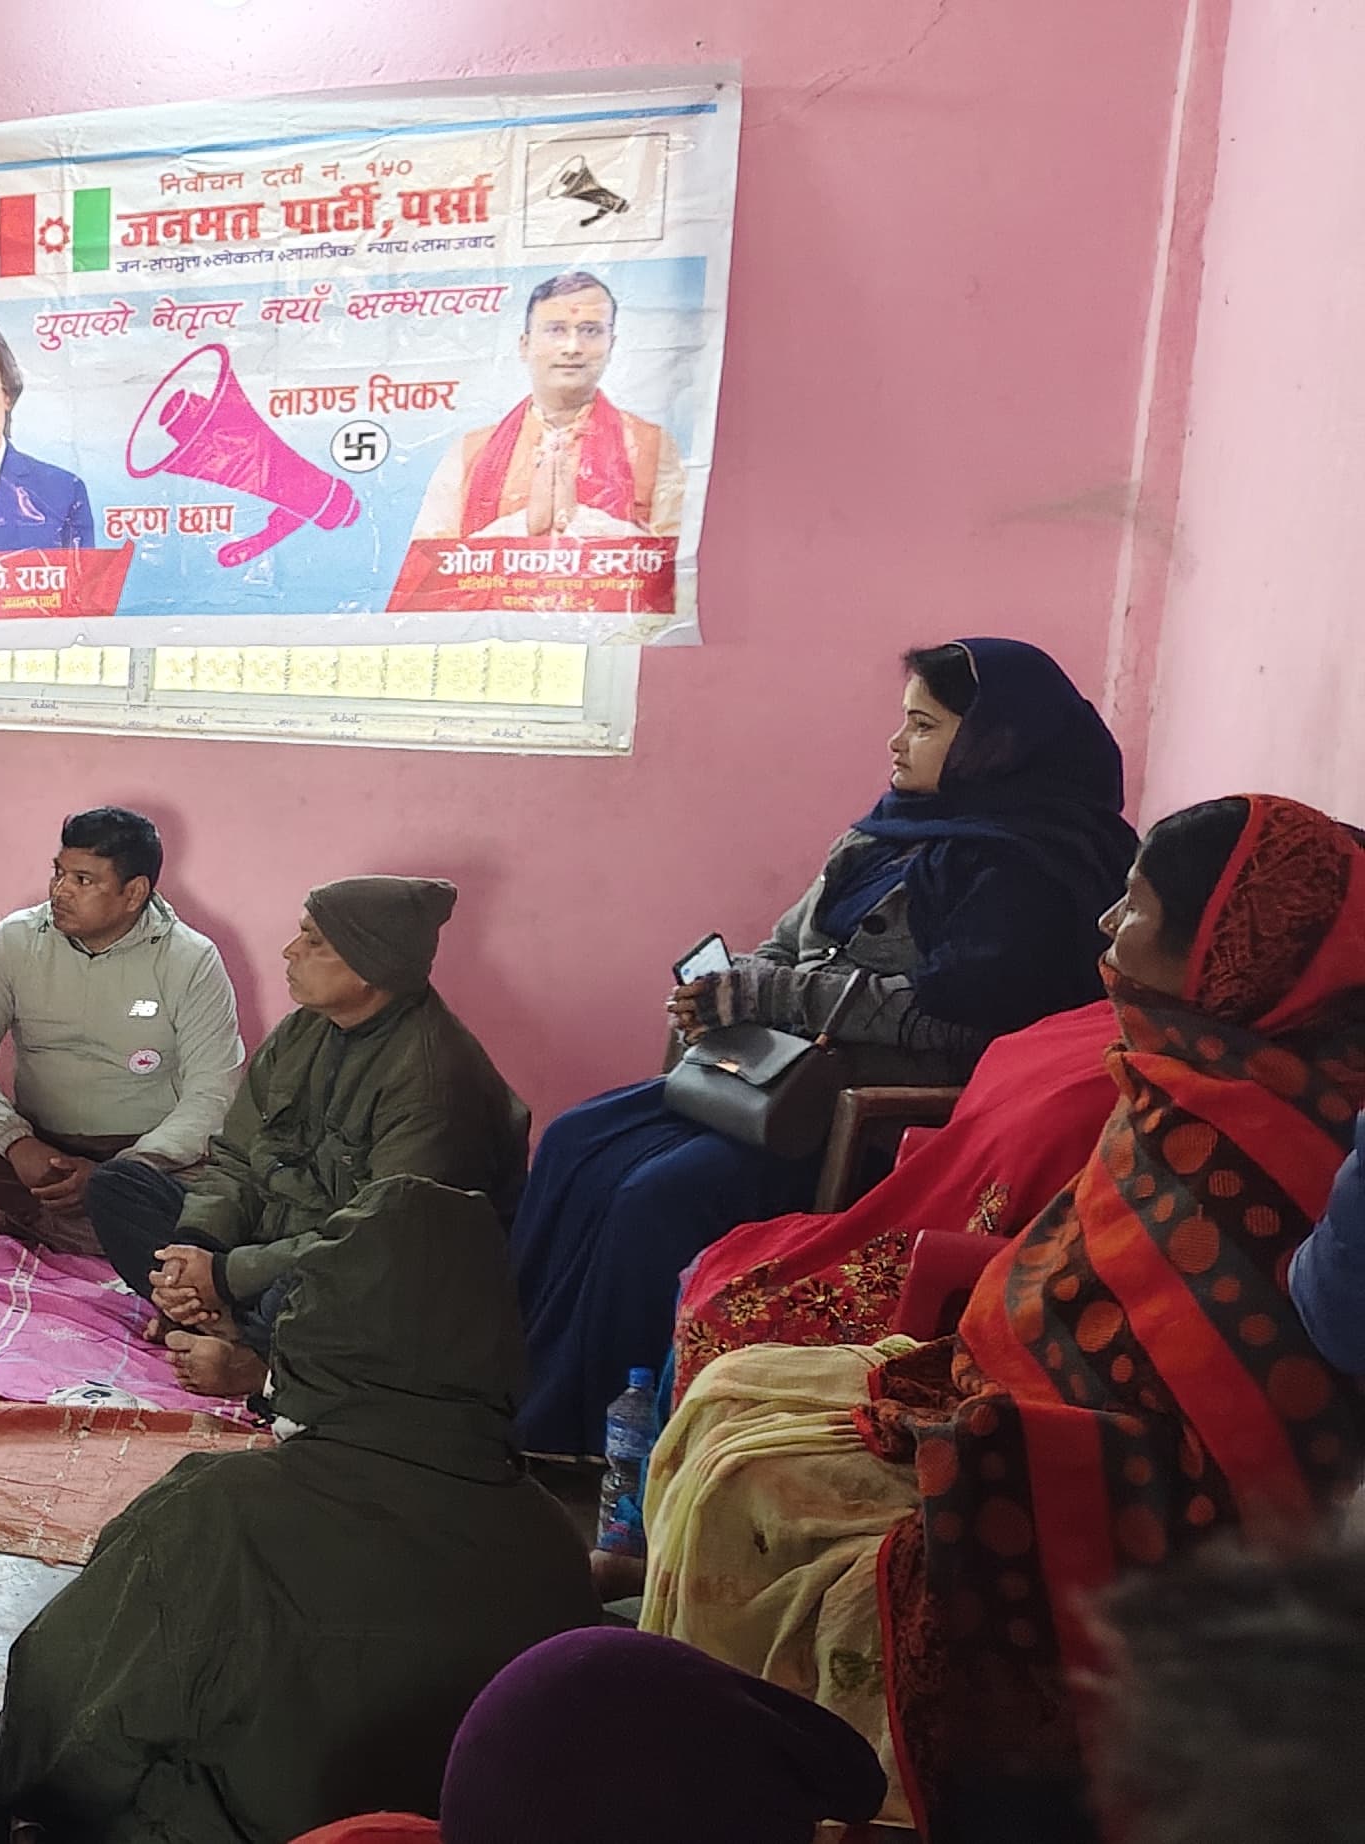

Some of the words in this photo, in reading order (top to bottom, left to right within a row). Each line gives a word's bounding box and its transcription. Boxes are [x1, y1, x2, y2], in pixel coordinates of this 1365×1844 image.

[160, 170, 244, 196] निर्वाचन
[117, 201, 265, 247] जनमत
[398, 173, 495, 227] पर्सा
[286, 241, 356, 262] सामाजिक
[368, 238, 409, 254] न्याय
[420, 234, 497, 252] समाजवाद
[34, 302, 136, 351] युवाको
[152, 298, 243, 340] नेतृत्व
[262, 283, 334, 324] नयाँ
[346, 285, 509, 321] सम्भावना
[269, 385, 360, 418] लाउण्ड
[368, 373, 460, 414] स्पिकर
[105, 505, 171, 539] हरण
[178, 504, 236, 535] छाप
[437, 544, 495, 575] ओम
[502, 548, 580, 576] प्रकाश
[15, 564, 68, 592] राउत
